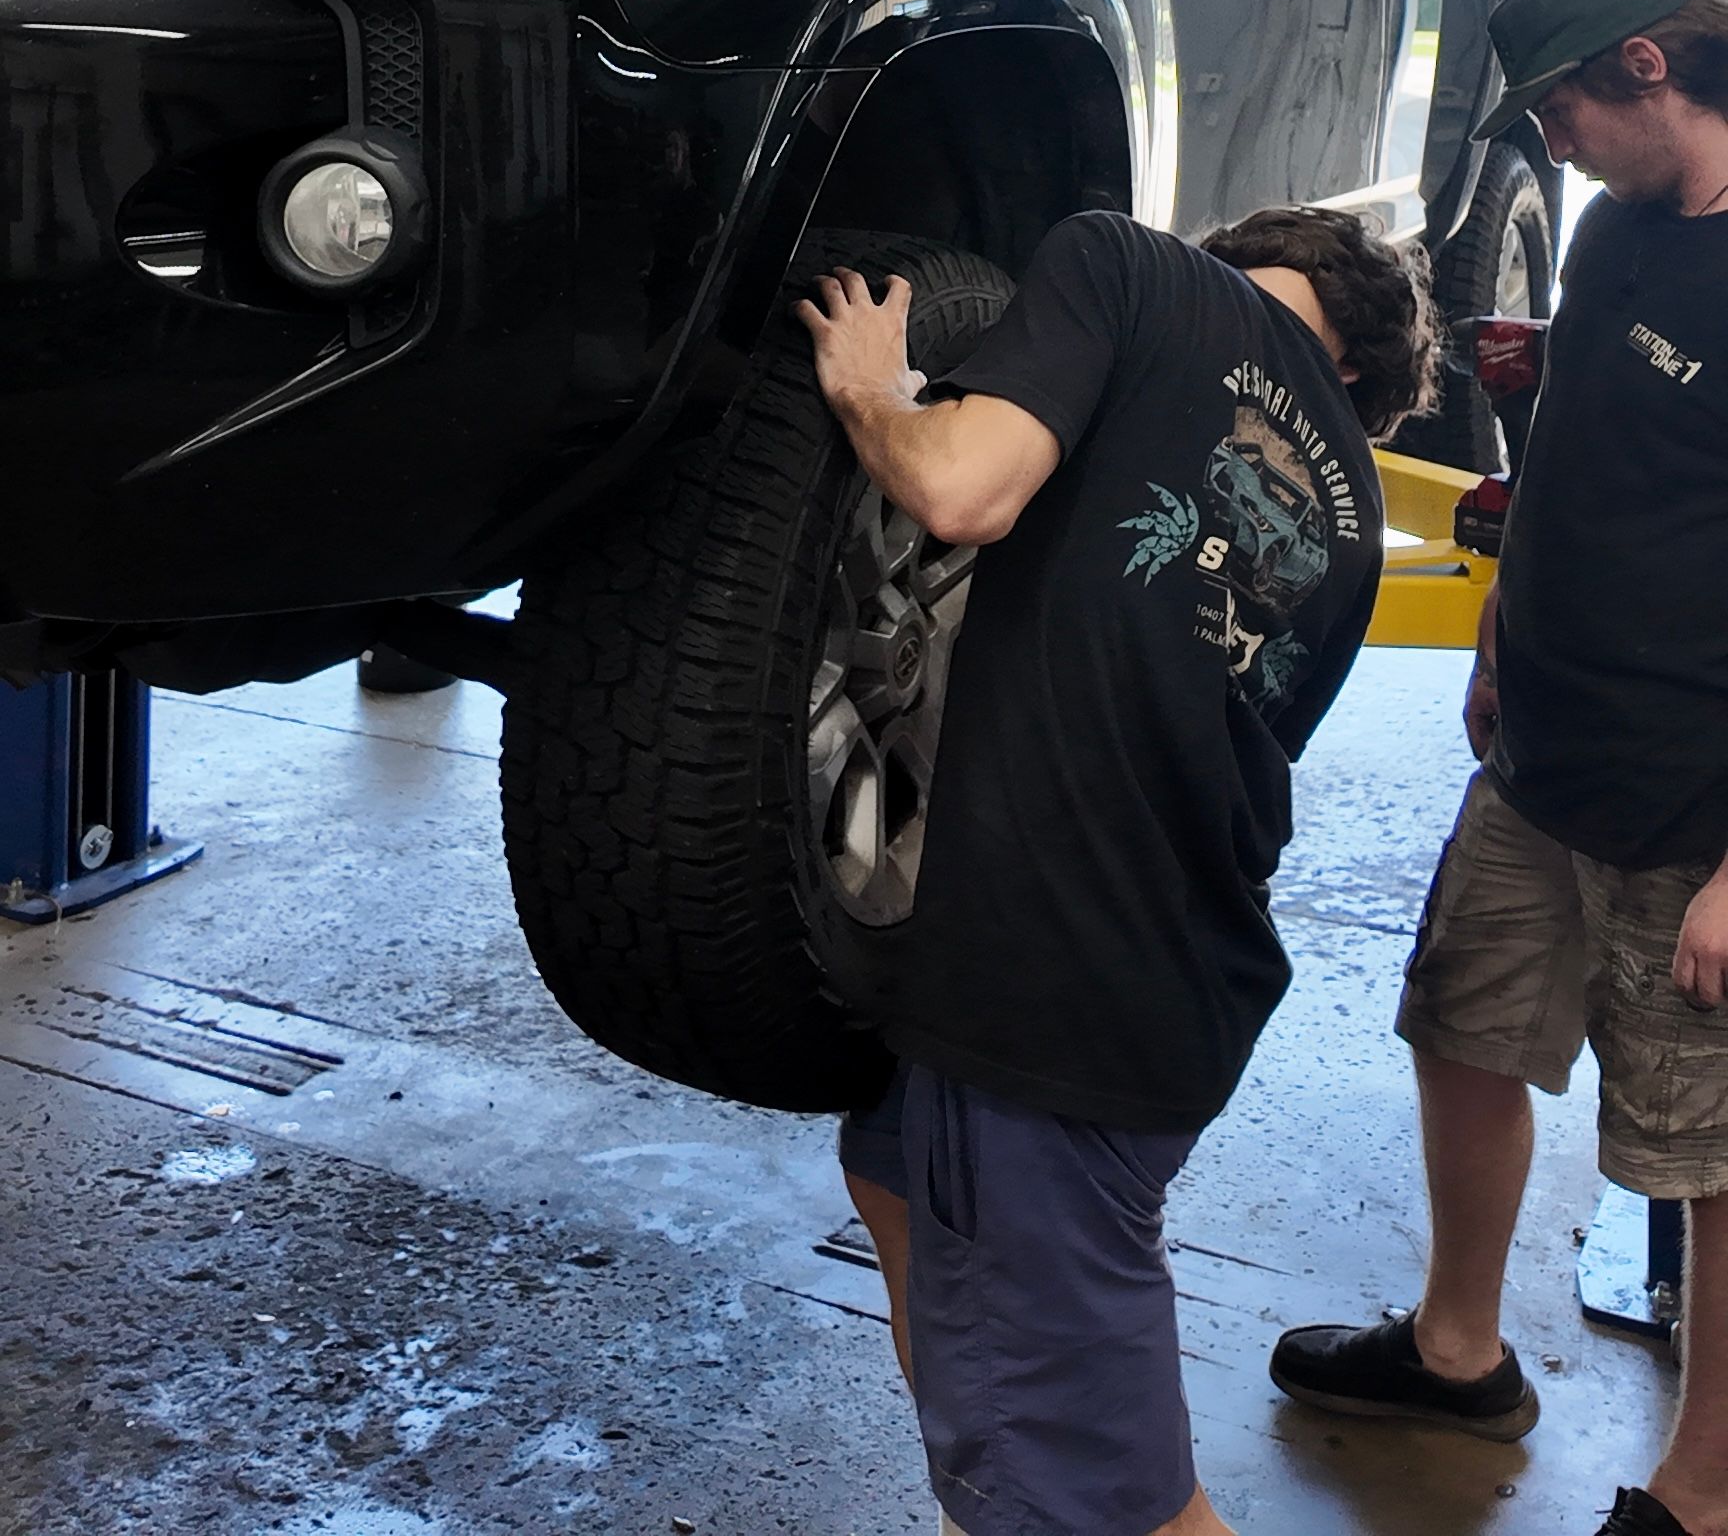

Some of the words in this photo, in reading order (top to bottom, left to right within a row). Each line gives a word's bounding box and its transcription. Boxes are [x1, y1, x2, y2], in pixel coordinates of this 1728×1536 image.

[1629, 323, 1677, 358] STATION
[1650, 350, 1683, 378] ONE
[1680, 360, 1703, 384] 1
[1292, 409, 1327, 461] AUTO
[1320, 459, 1360, 542] SERVICE
